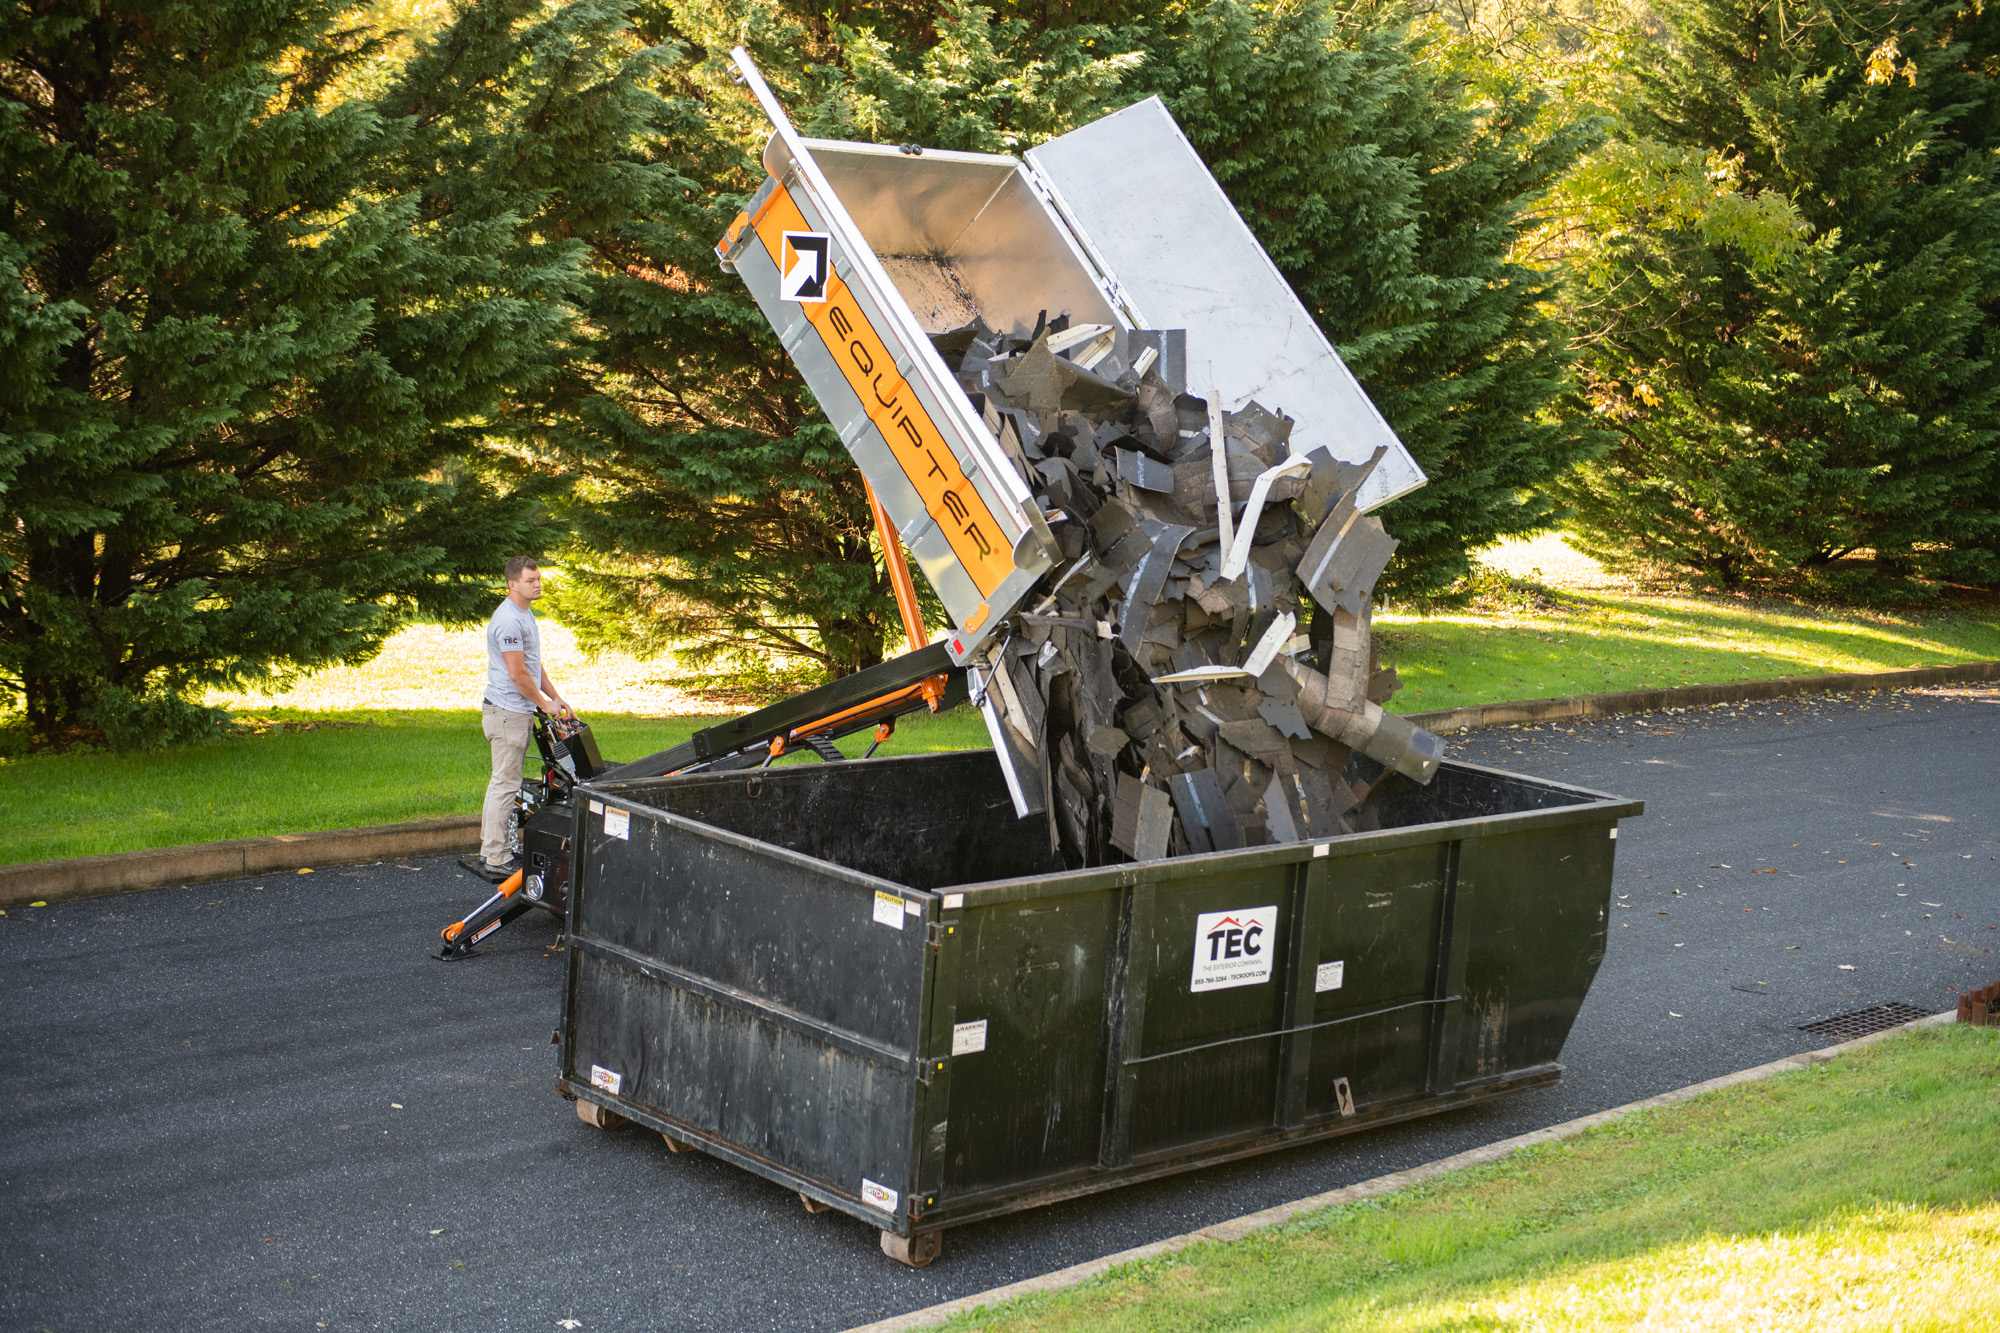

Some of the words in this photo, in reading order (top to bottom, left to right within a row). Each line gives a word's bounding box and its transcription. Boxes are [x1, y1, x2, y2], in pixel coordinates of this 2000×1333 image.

[881, 894, 903, 906] CAUTION
[1207, 926, 1263, 961] TEC
[1213, 962, 1237, 970] EXTERIOR
[1231, 970, 1267, 979] TECROOFS.COM
[960, 1022, 985, 1032] WARNING
